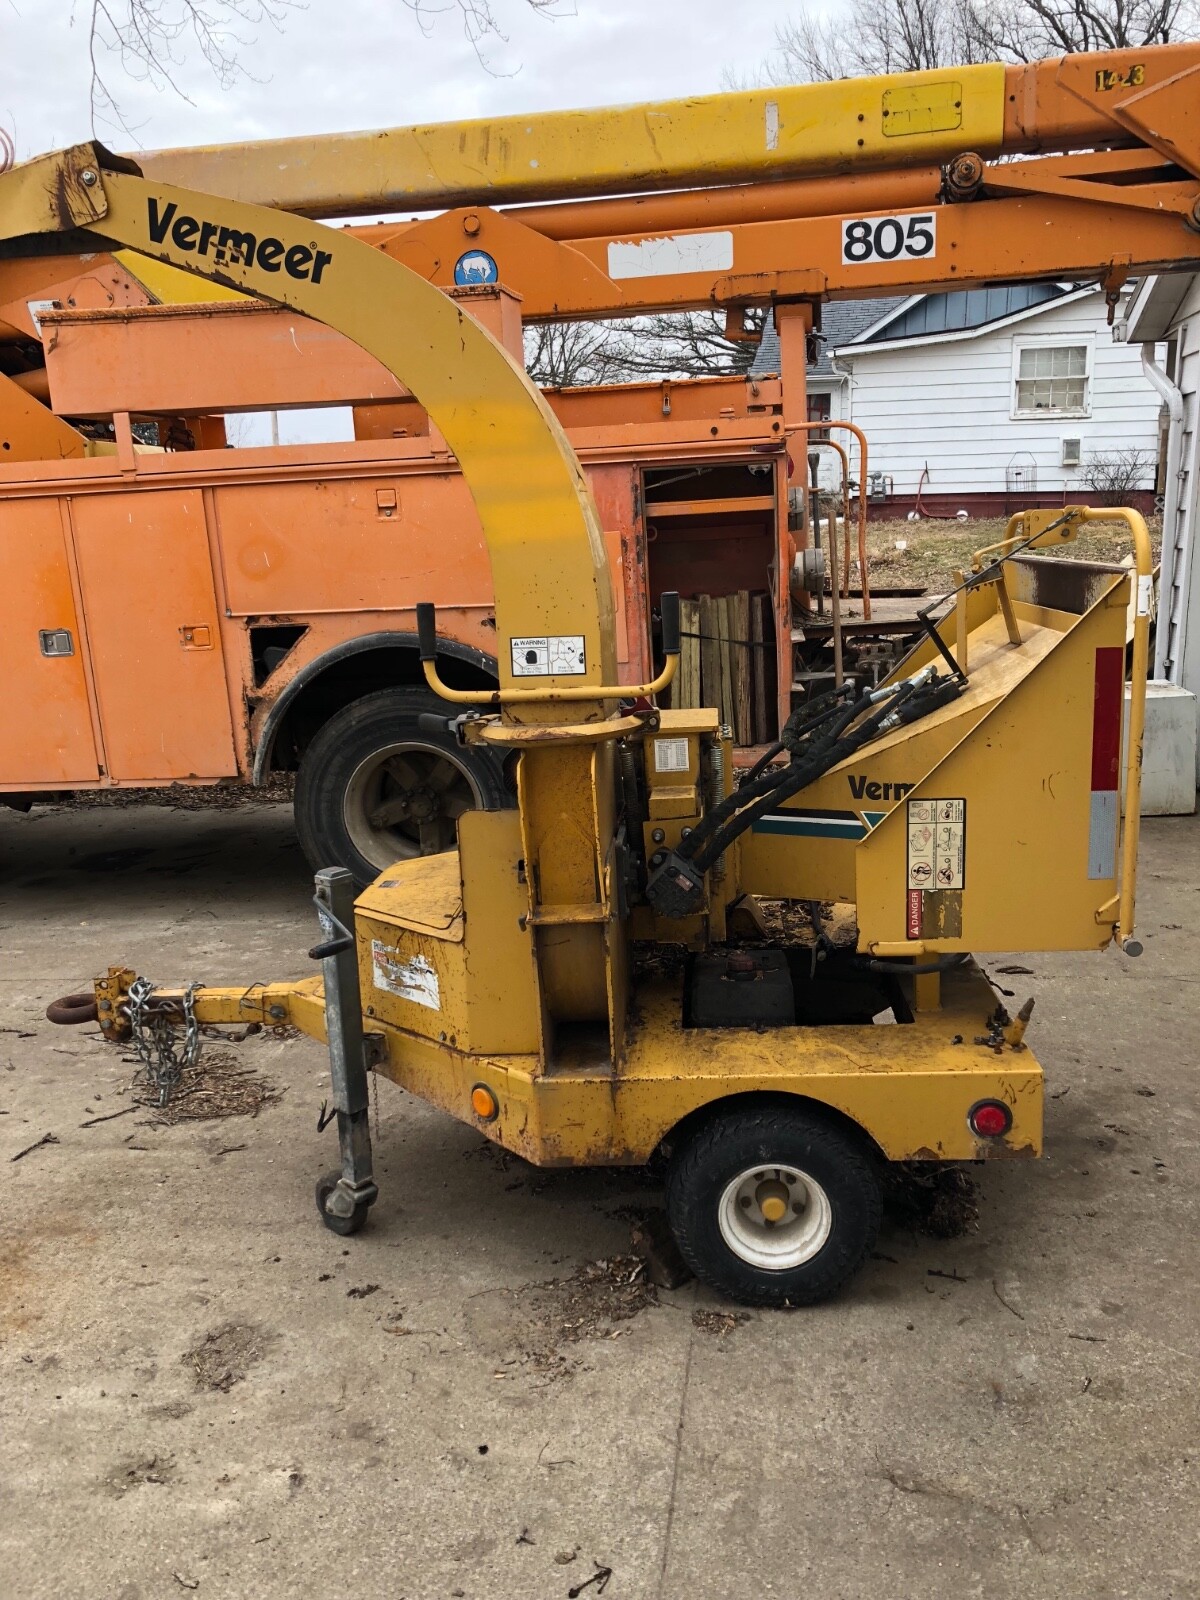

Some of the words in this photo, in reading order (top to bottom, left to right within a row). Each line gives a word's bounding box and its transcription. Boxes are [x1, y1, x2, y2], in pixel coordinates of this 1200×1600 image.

[147, 197, 333, 285] Vermeer
[843, 216, 934, 262] 805
[519, 639, 546, 647] WARNING
[911, 891, 919, 926] DANGER
